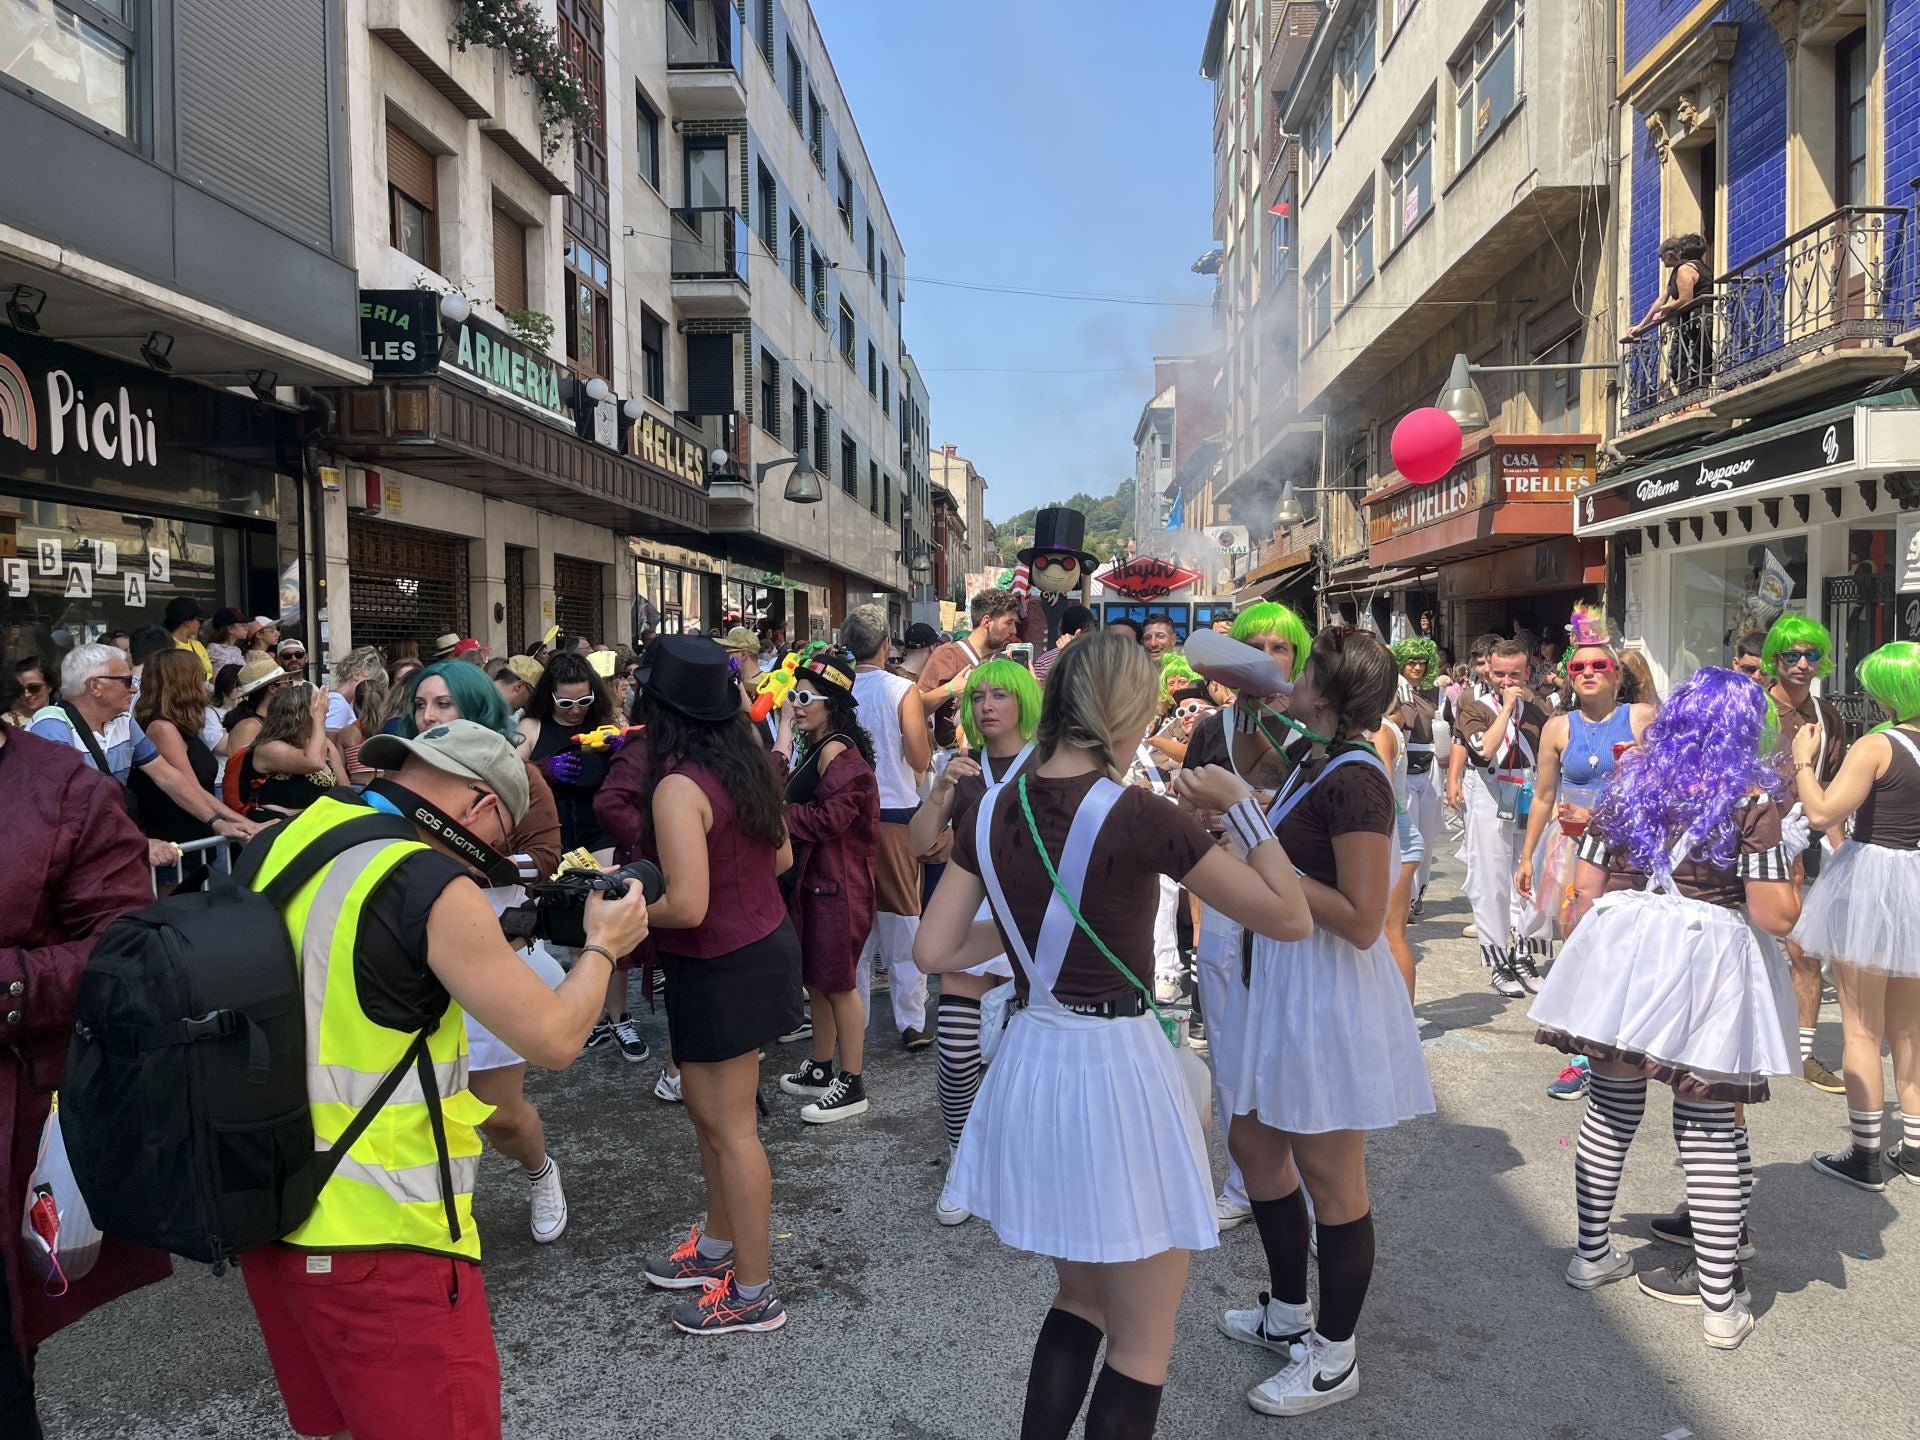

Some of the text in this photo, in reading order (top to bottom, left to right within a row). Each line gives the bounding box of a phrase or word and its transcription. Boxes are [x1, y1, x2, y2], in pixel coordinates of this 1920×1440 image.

[47, 370, 157, 467] Pichi
[1502, 453, 1539, 467] CASA
[1502, 475, 1590, 493] TRELLES
[1409, 471, 1468, 527] TRELLES
[415, 808, 486, 862] EOS DIGITAL
